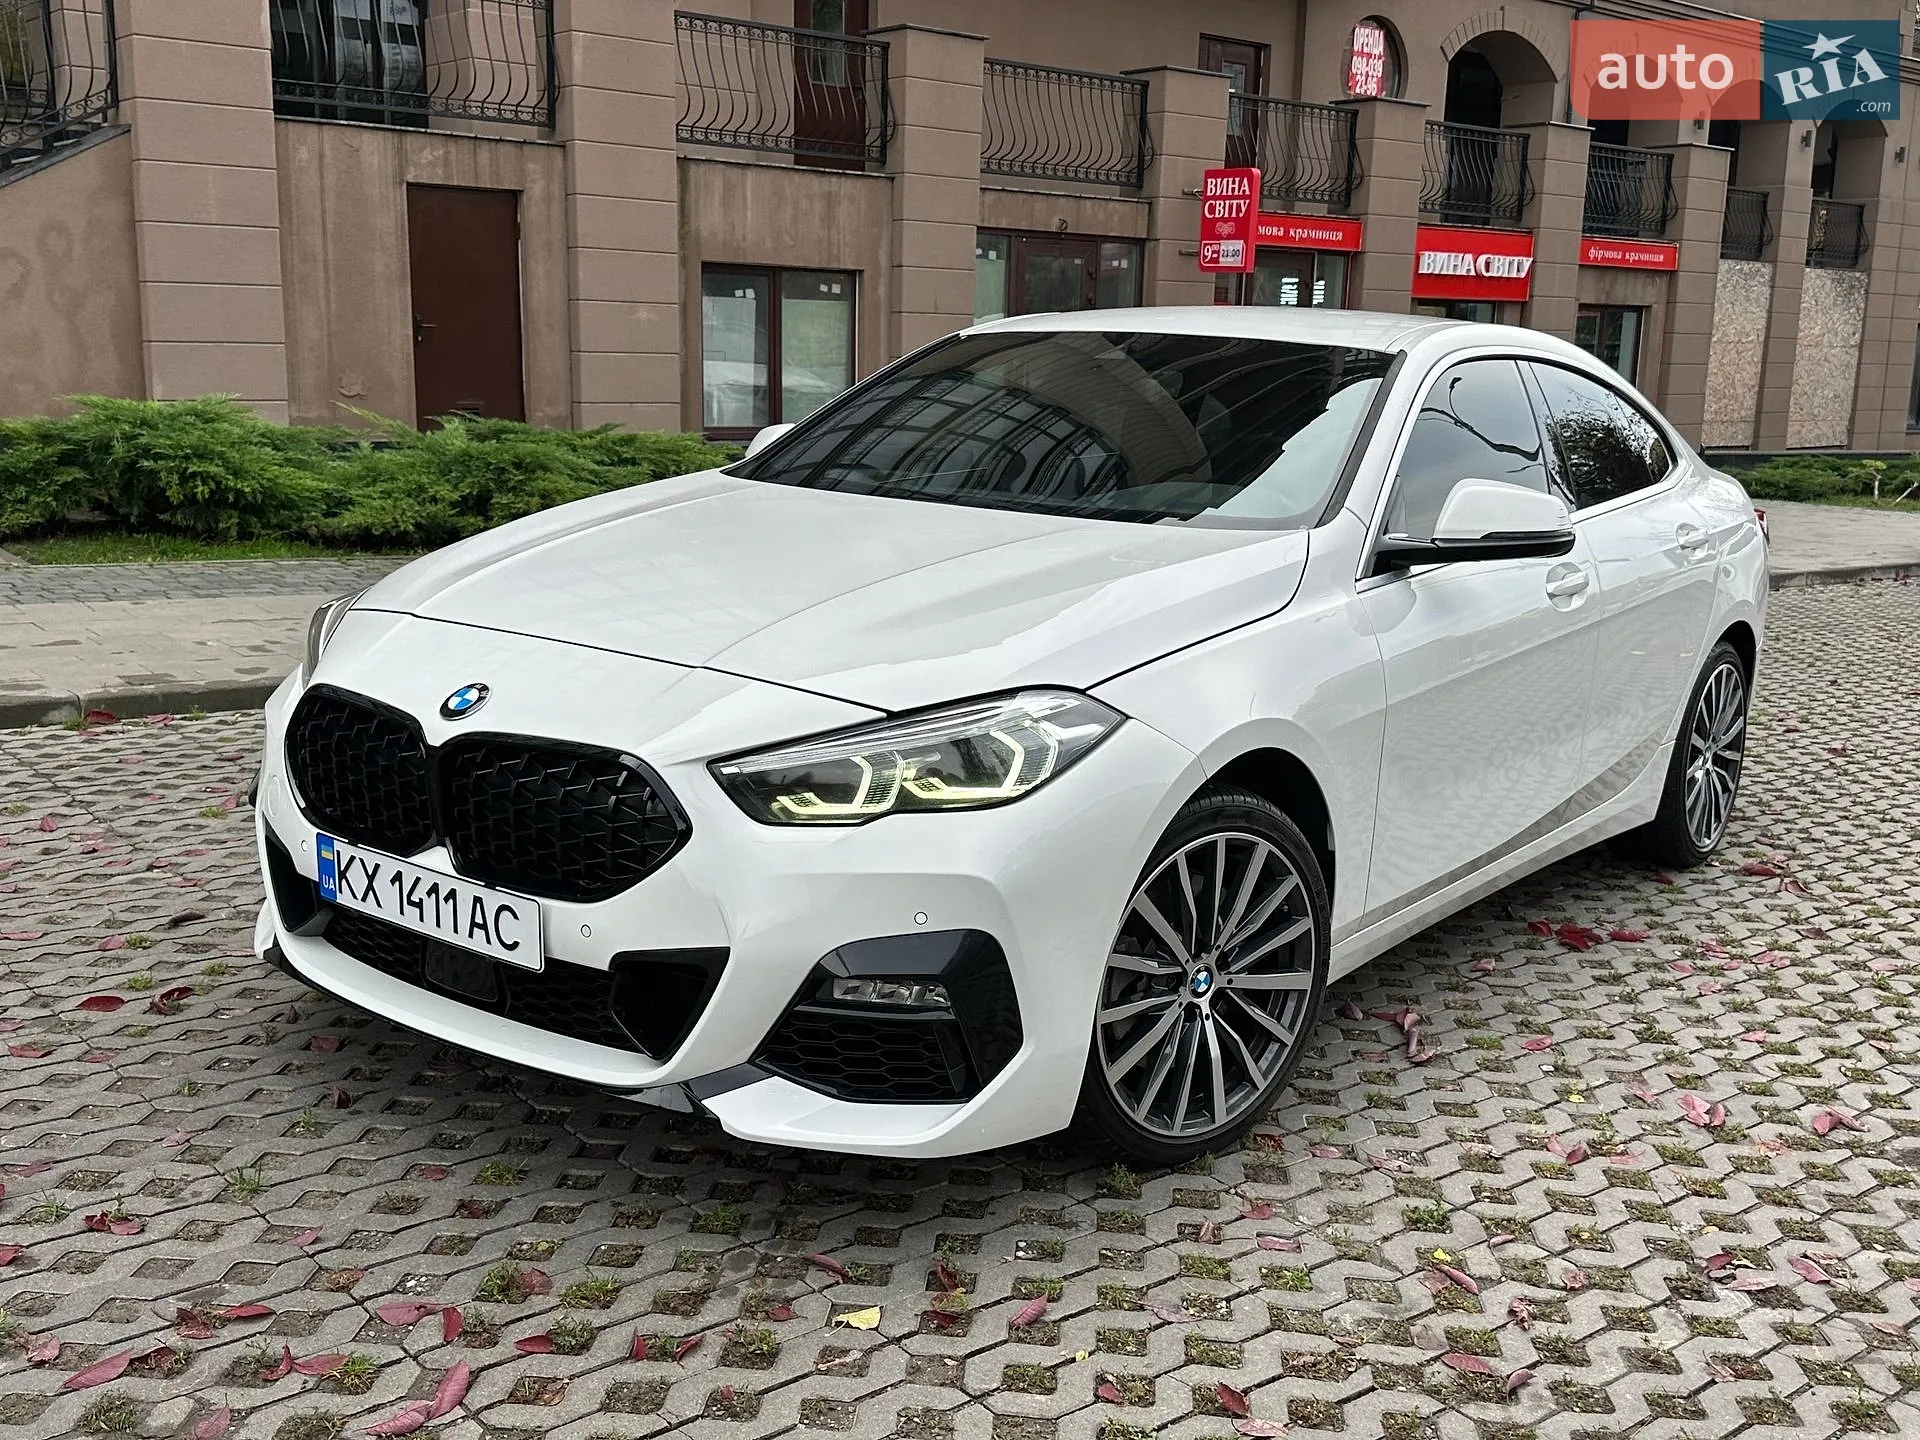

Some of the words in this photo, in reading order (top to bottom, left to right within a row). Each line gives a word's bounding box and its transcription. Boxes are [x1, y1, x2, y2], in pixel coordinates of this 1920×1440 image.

[1353, 27, 1384, 58] ОРЕНДА
[1206, 177, 1250, 196] ВИНА
[1204, 199, 1250, 218] СВІТУ
[1257, 225, 1284, 237] мова
[1289, 228, 1343, 241] крамниця
[1588, 246, 1622, 261] фірмова
[1418, 251, 1476, 276] ВИНА
[1476, 254, 1533, 278] СВІТУ
[322, 874, 335, 891] UA
[336, 849, 383, 909] KX
[389, 869, 459, 935] 1411
[468, 894, 520, 951] AC
